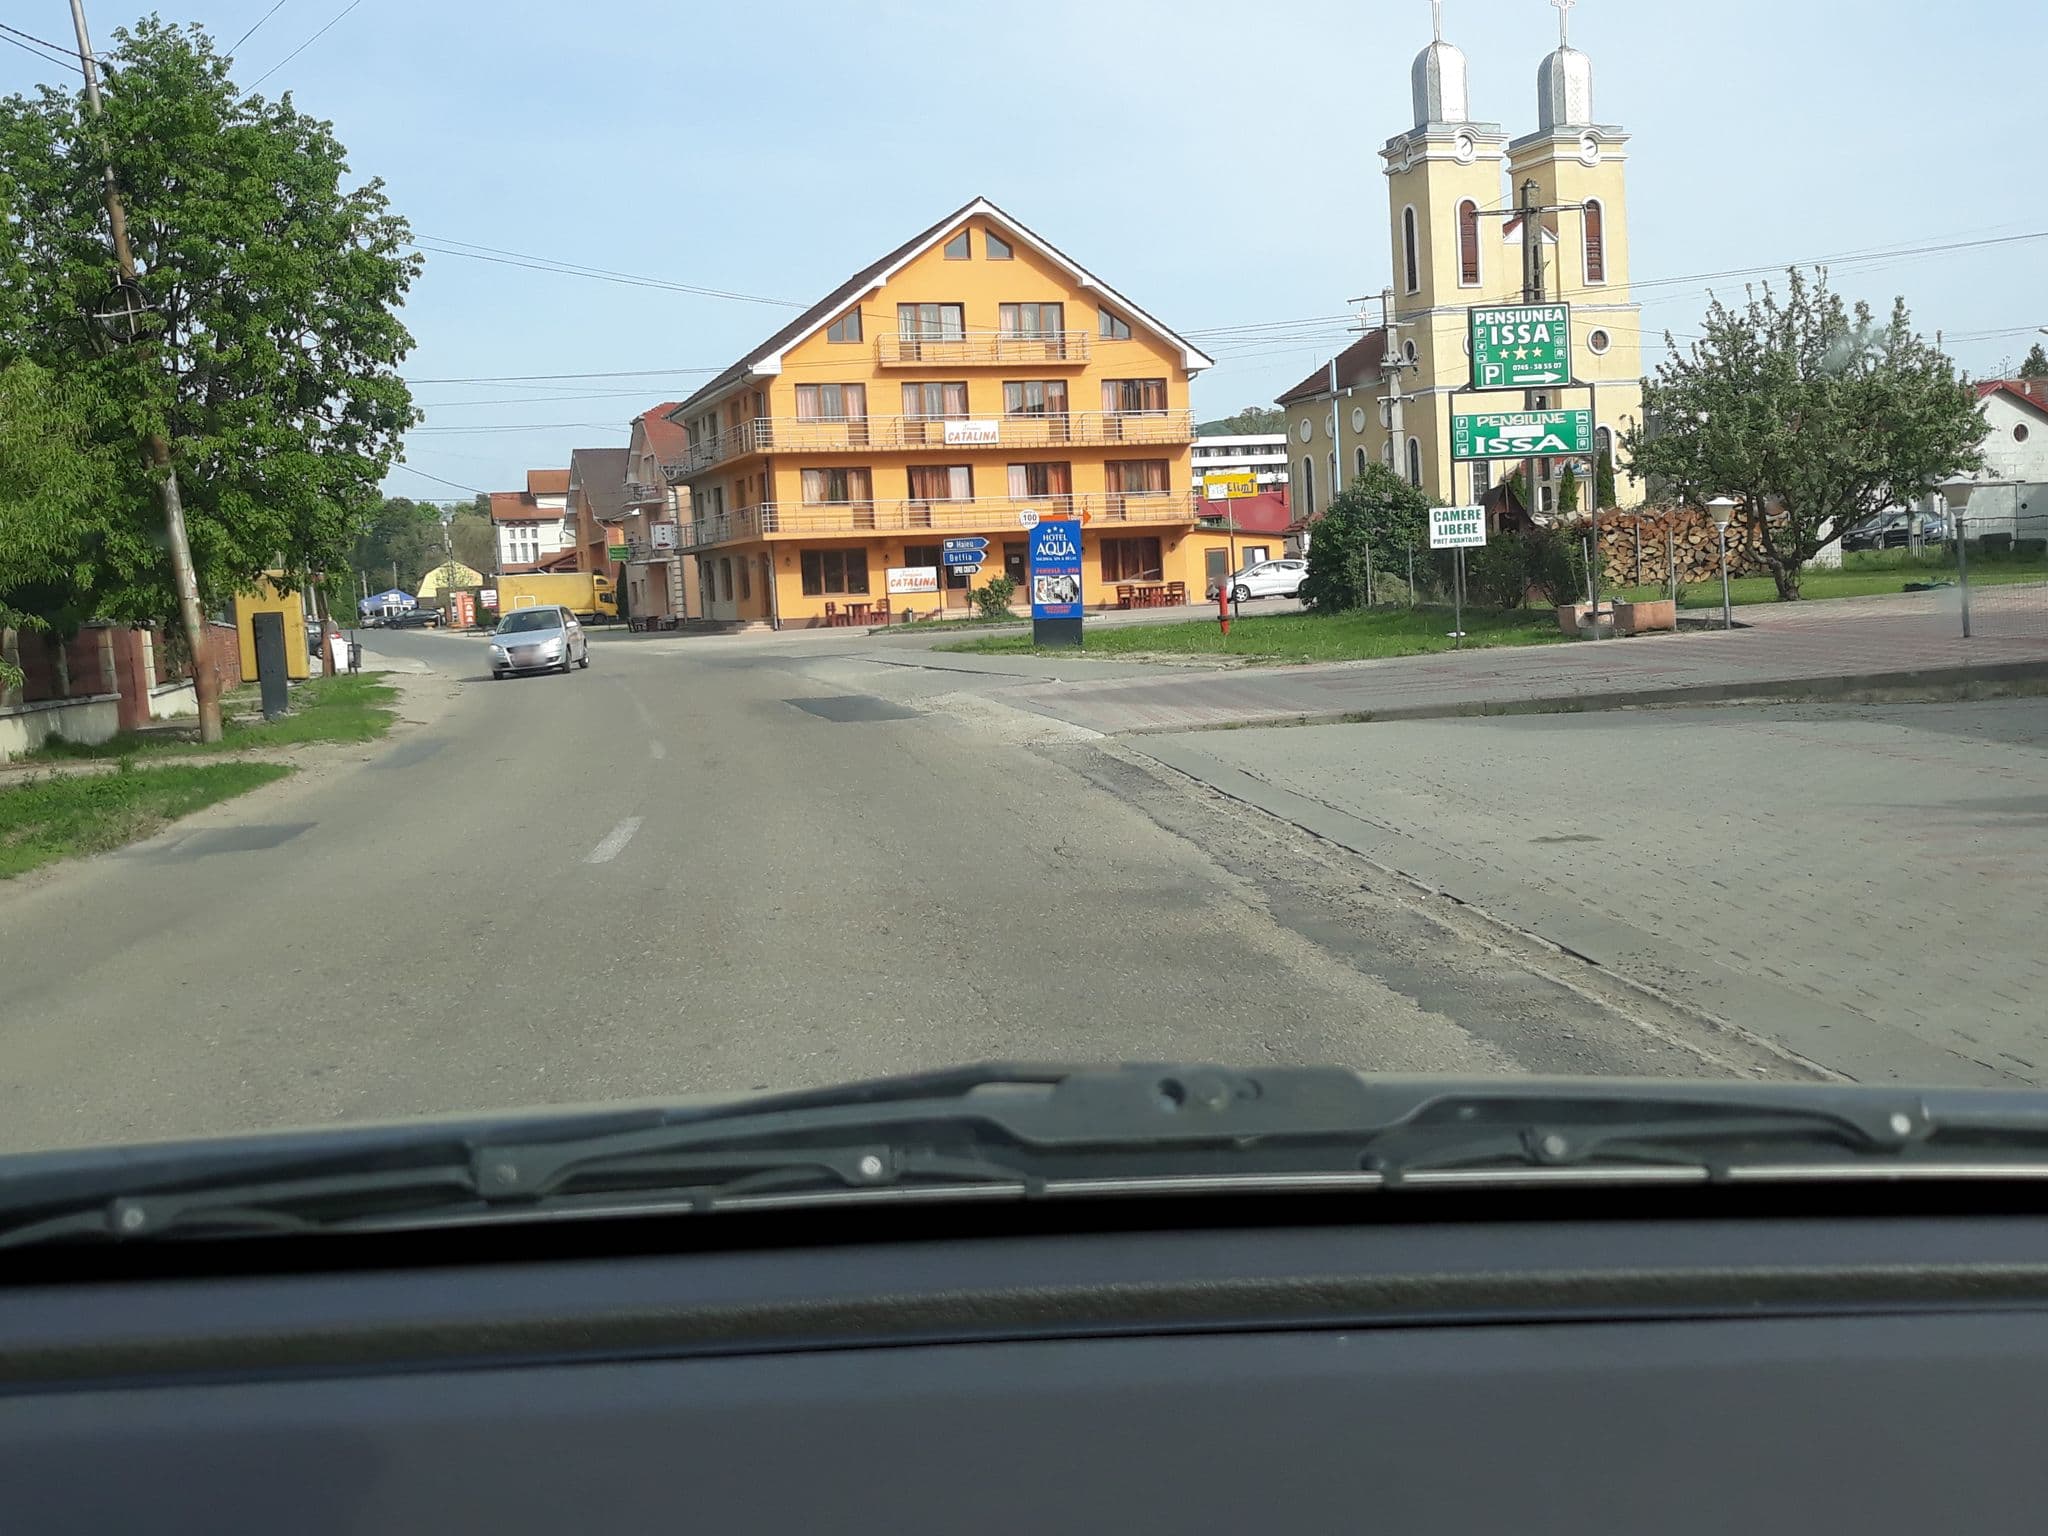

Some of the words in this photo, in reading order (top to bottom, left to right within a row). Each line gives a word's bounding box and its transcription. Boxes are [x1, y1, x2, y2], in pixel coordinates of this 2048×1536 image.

[1475, 309, 1564, 325] PENSIUNEA
[1490, 323, 1551, 346] ISSA
[1485, 365, 1500, 385] P
[1476, 412, 1567, 428] PENSIUNE
[947, 431, 997, 442] CATALINA
[1474, 433, 1570, 454] ISSA
[1023, 513, 1037, 522] 100
[1433, 509, 1482, 523] CAMERE
[1438, 522, 1478, 536] LIBERE
[1042, 533, 1068, 542] HOTEL
[1036, 541, 1076, 556] AQUA
[890, 576, 936, 588] CATALINA
